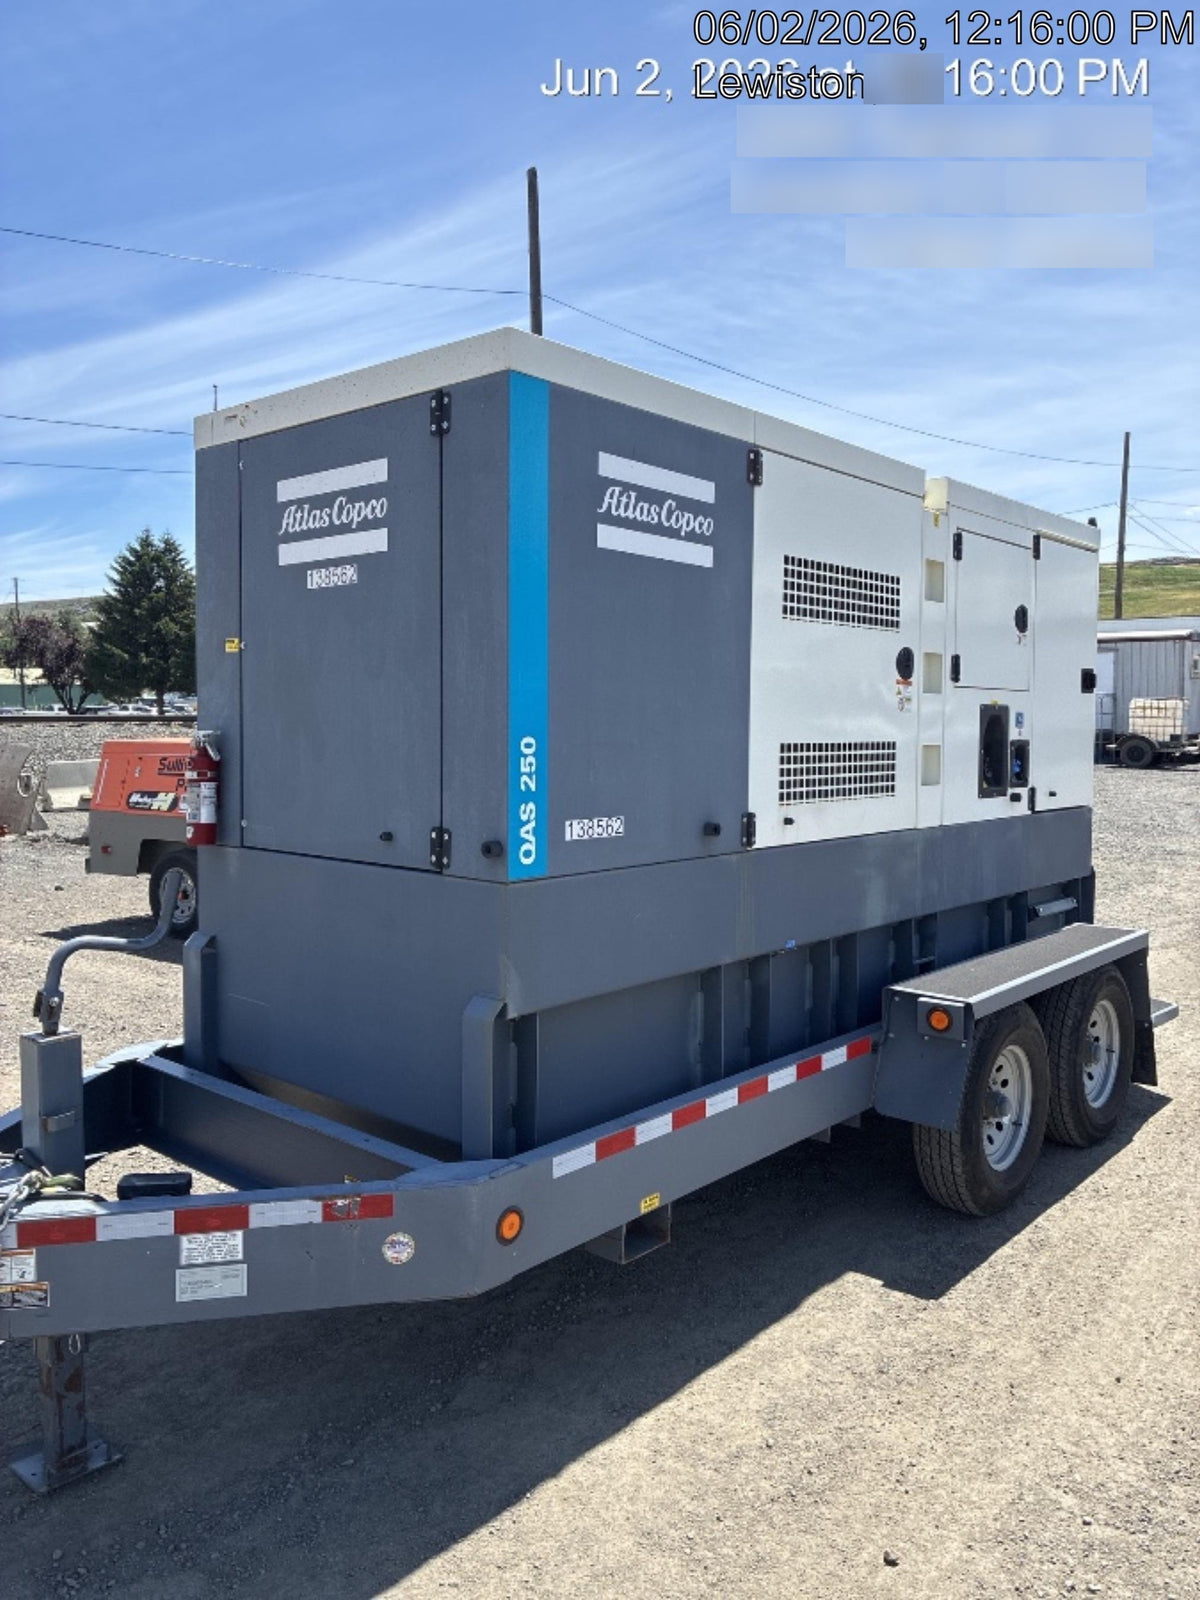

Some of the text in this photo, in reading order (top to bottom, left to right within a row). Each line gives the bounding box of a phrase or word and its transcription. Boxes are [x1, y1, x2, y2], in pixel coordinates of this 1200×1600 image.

[278, 496, 388, 536] Atlas Copco
[597, 486, 714, 537] Atlas Copco
[520, 736, 536, 792] 250
[567, 817, 624, 839] 138562
